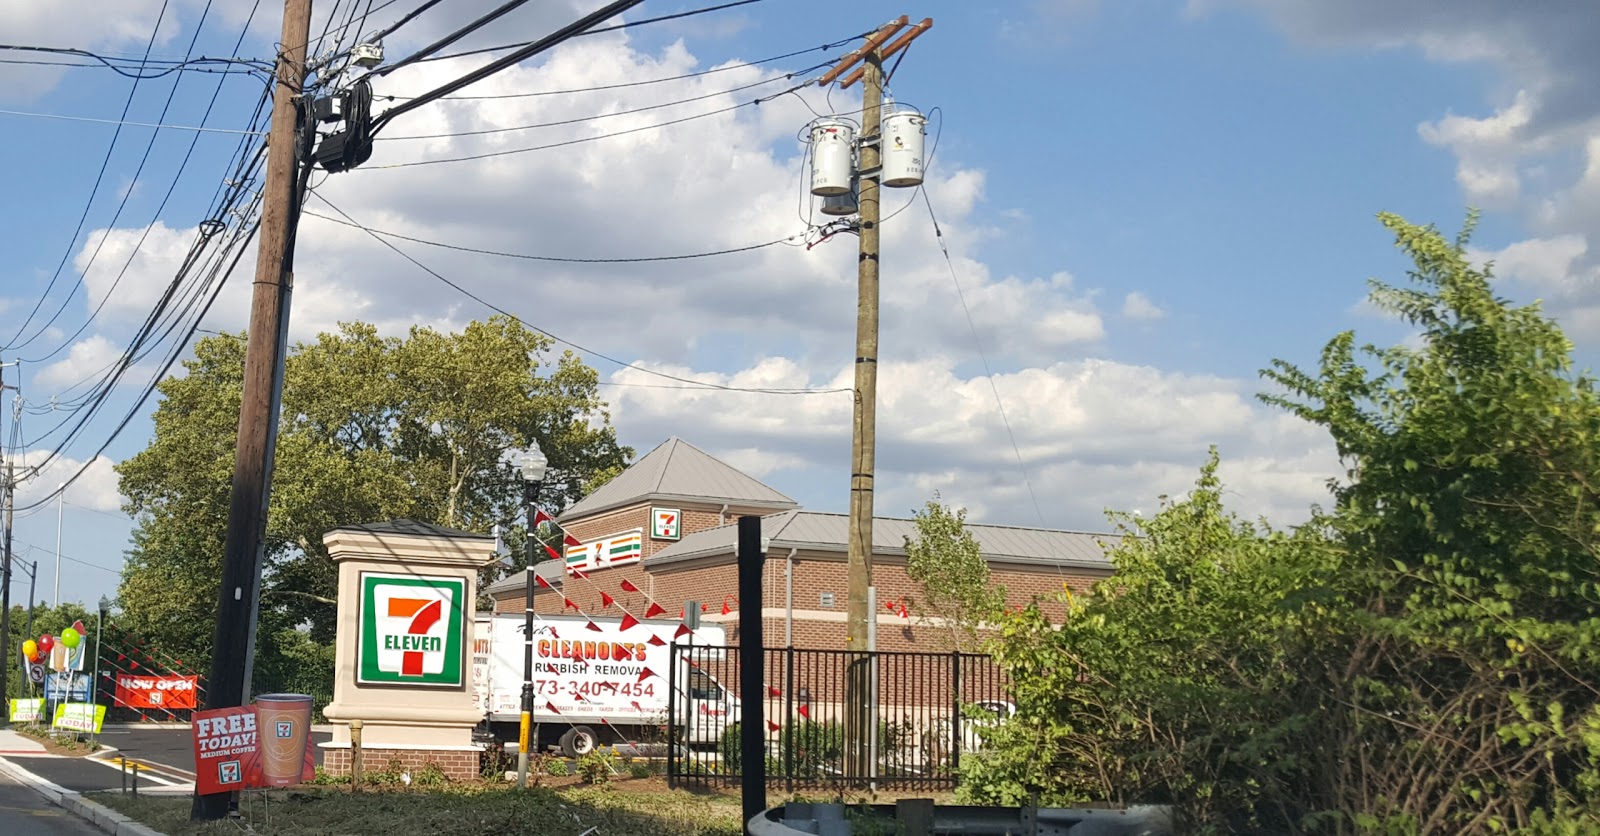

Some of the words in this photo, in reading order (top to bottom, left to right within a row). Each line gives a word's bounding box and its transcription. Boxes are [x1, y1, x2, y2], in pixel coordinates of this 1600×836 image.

[388, 597, 442, 676] 7
[594, 665, 643, 676] REMOVA
[120, 677, 154, 690] NOW
[156, 679, 193, 691] OPEN
[532, 679, 655, 697] 73-340-7454
[196, 713, 257, 738] FREE
[198, 731, 257, 751] TODAY!
[200, 749, 231, 759] MEDIUM
[231, 745, 256, 755] COFFEE
